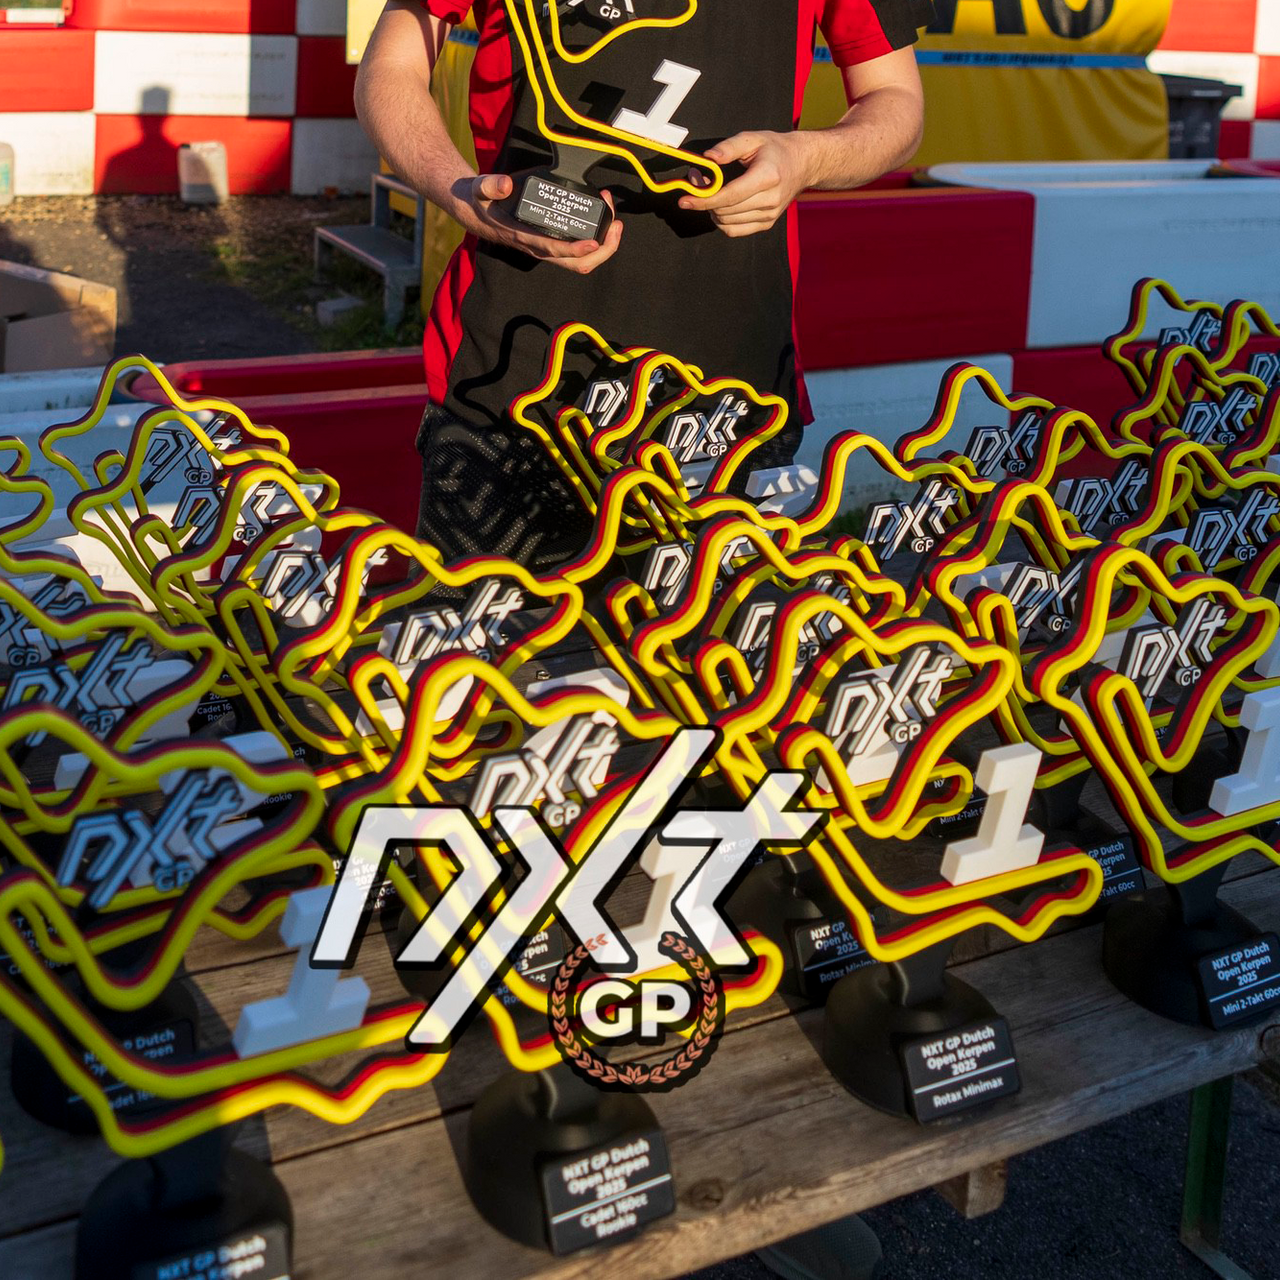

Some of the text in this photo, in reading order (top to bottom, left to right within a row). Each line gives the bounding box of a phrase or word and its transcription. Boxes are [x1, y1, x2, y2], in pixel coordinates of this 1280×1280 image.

[598, 4, 621, 21] GP
[612, 59, 702, 148] 1
[538, 182, 593, 207] NXT GP Dutch
[538, 190, 589, 213] Open Kerpen
[529, 205, 587, 230] Mini 2-Takt 60cc
[552, 202, 571, 214] 2025
[544, 217, 569, 231] Rookie
[1176, 664, 1202, 687] GP
[891, 718, 922, 745] GP
[939, 740, 1046, 888] 1
[810, 924, 831, 940] NXT
[1212, 941, 1270, 970] NXT GP Dutch
[1217, 955, 1271, 981] Open Kerpen
[1236, 970, 1258, 986] 2025
[1222, 1000, 1241, 1016] Mini
[1239, 992, 1265, 1009] 2-Takt
[921, 1025, 995, 1059] NXT GP Dutch
[926, 1039, 996, 1070] Open Kerpen
[950, 1058, 977, 1076] 2025
[932, 1076, 1005, 1108] Rotax Minimax
